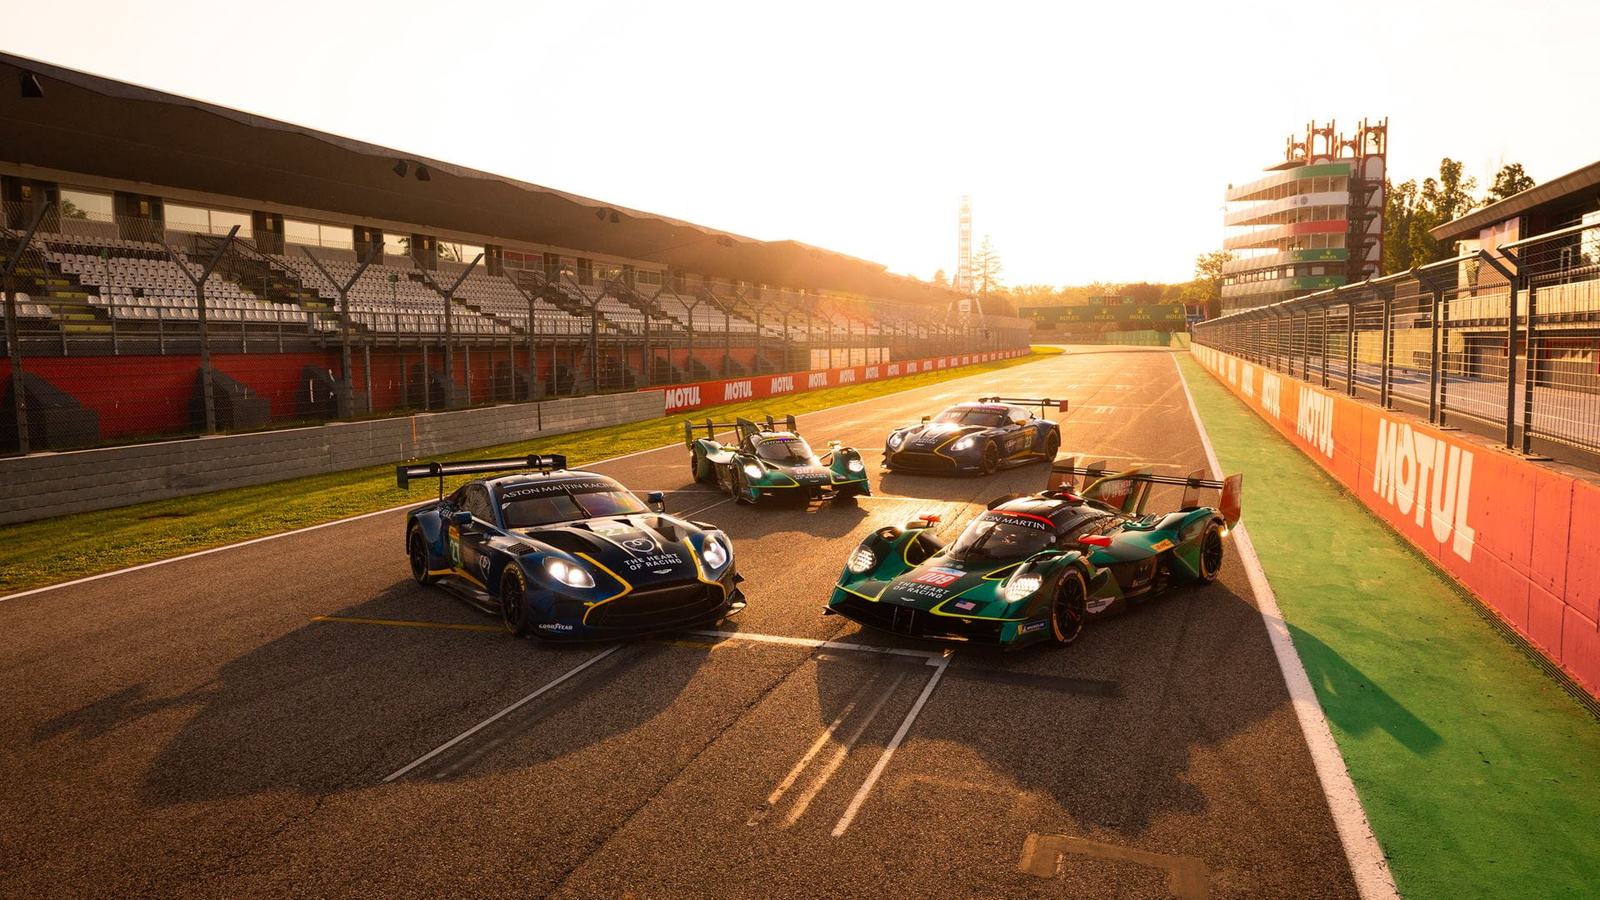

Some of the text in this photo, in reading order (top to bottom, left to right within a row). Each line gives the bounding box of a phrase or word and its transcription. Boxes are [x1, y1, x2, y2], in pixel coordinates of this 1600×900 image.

[771, 376, 793, 394] MOTUL
[808, 372, 827, 388] MOTUL
[665, 386, 701, 409] MOTUL
[724, 381, 752, 400] MOTUL
[1296, 386, 1334, 459] MOTUL
[502, 488, 540, 499] ASTON
[1372, 418, 1475, 563] MOTUL
[1002, 518, 1046, 530] MARTIN
[623, 553, 679, 566] THE HEART
[645, 558, 682, 568] RACING
[906, 587, 943, 599] RACING
[917, 584, 950, 595] HEART
